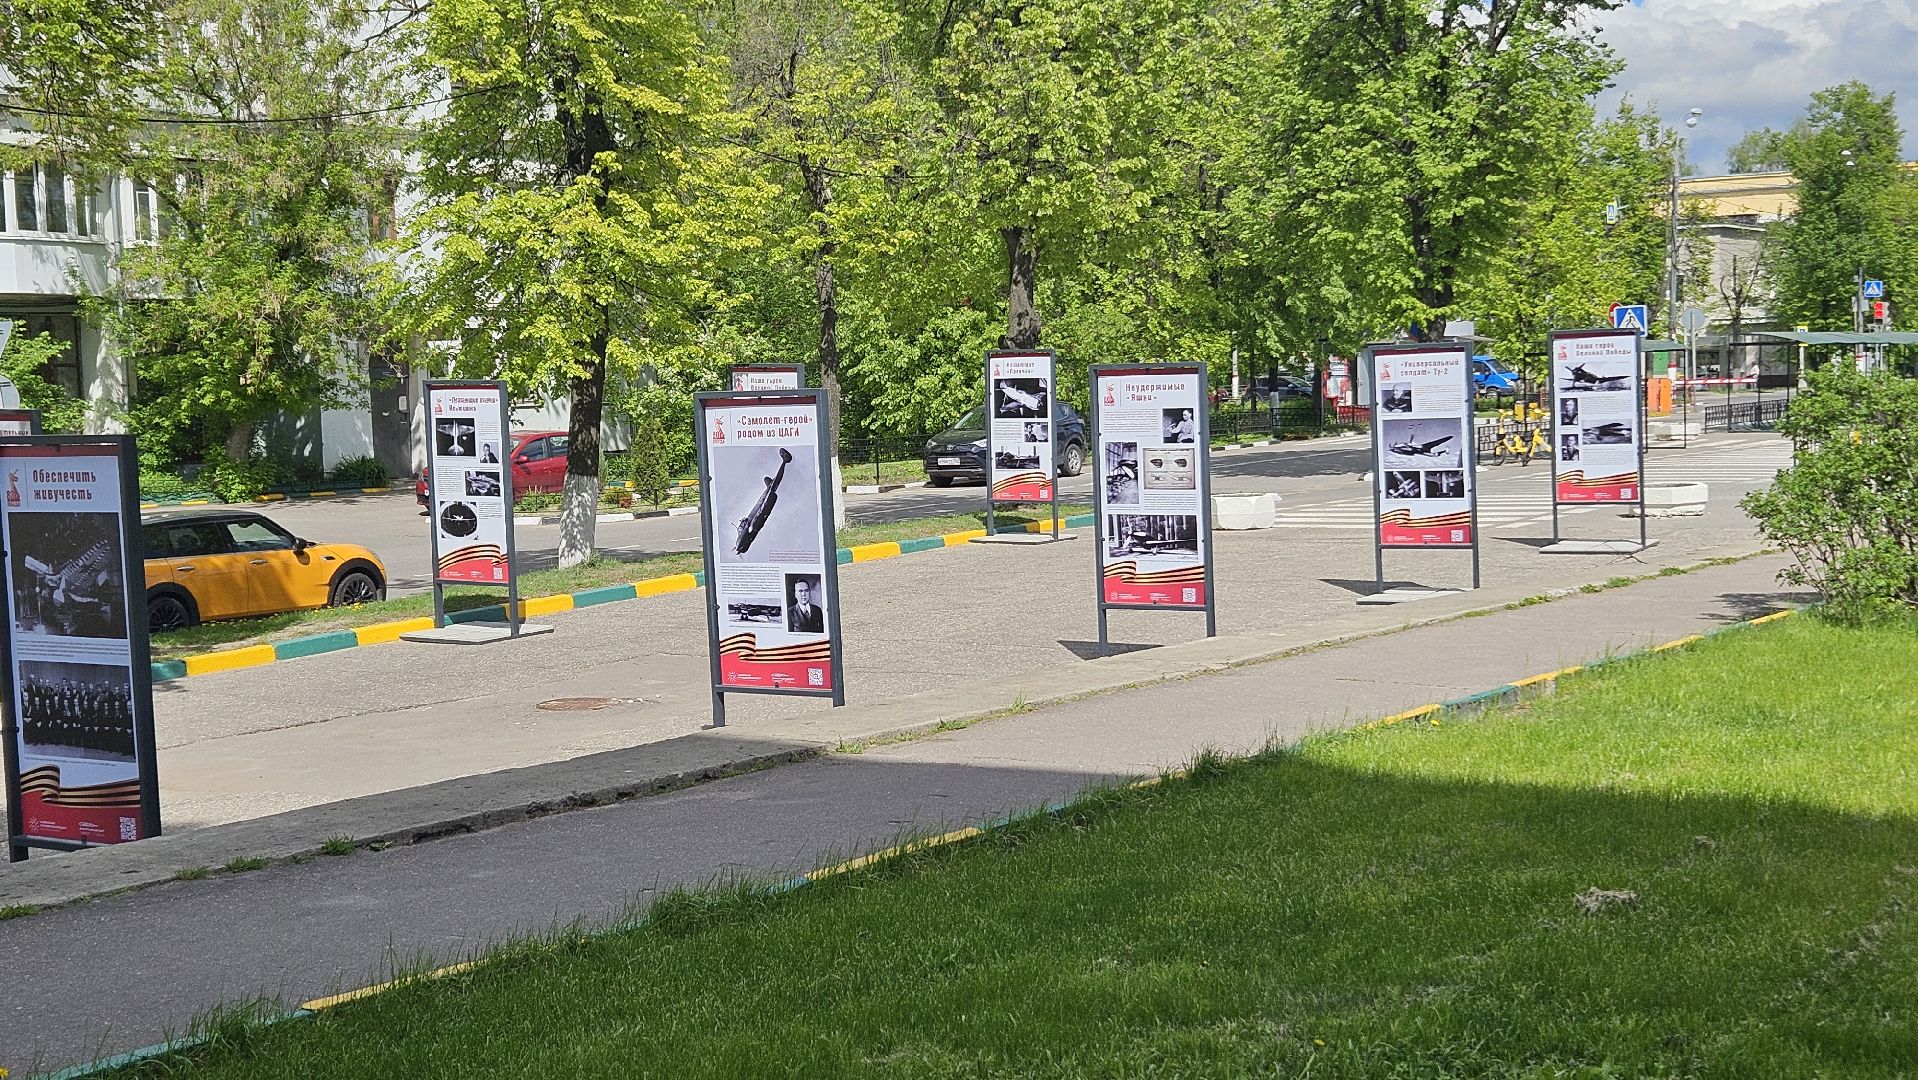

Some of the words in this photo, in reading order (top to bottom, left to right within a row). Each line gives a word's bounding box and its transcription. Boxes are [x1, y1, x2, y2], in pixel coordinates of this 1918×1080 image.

[1125, 383, 1185, 392] Неудержимые
[737, 429, 763, 440] родом
[766, 429, 775, 437] из
[779, 427, 799, 438] ЦАГИ
[33, 469, 96, 482] Обеспечить
[34, 489, 92, 502] живучесть
